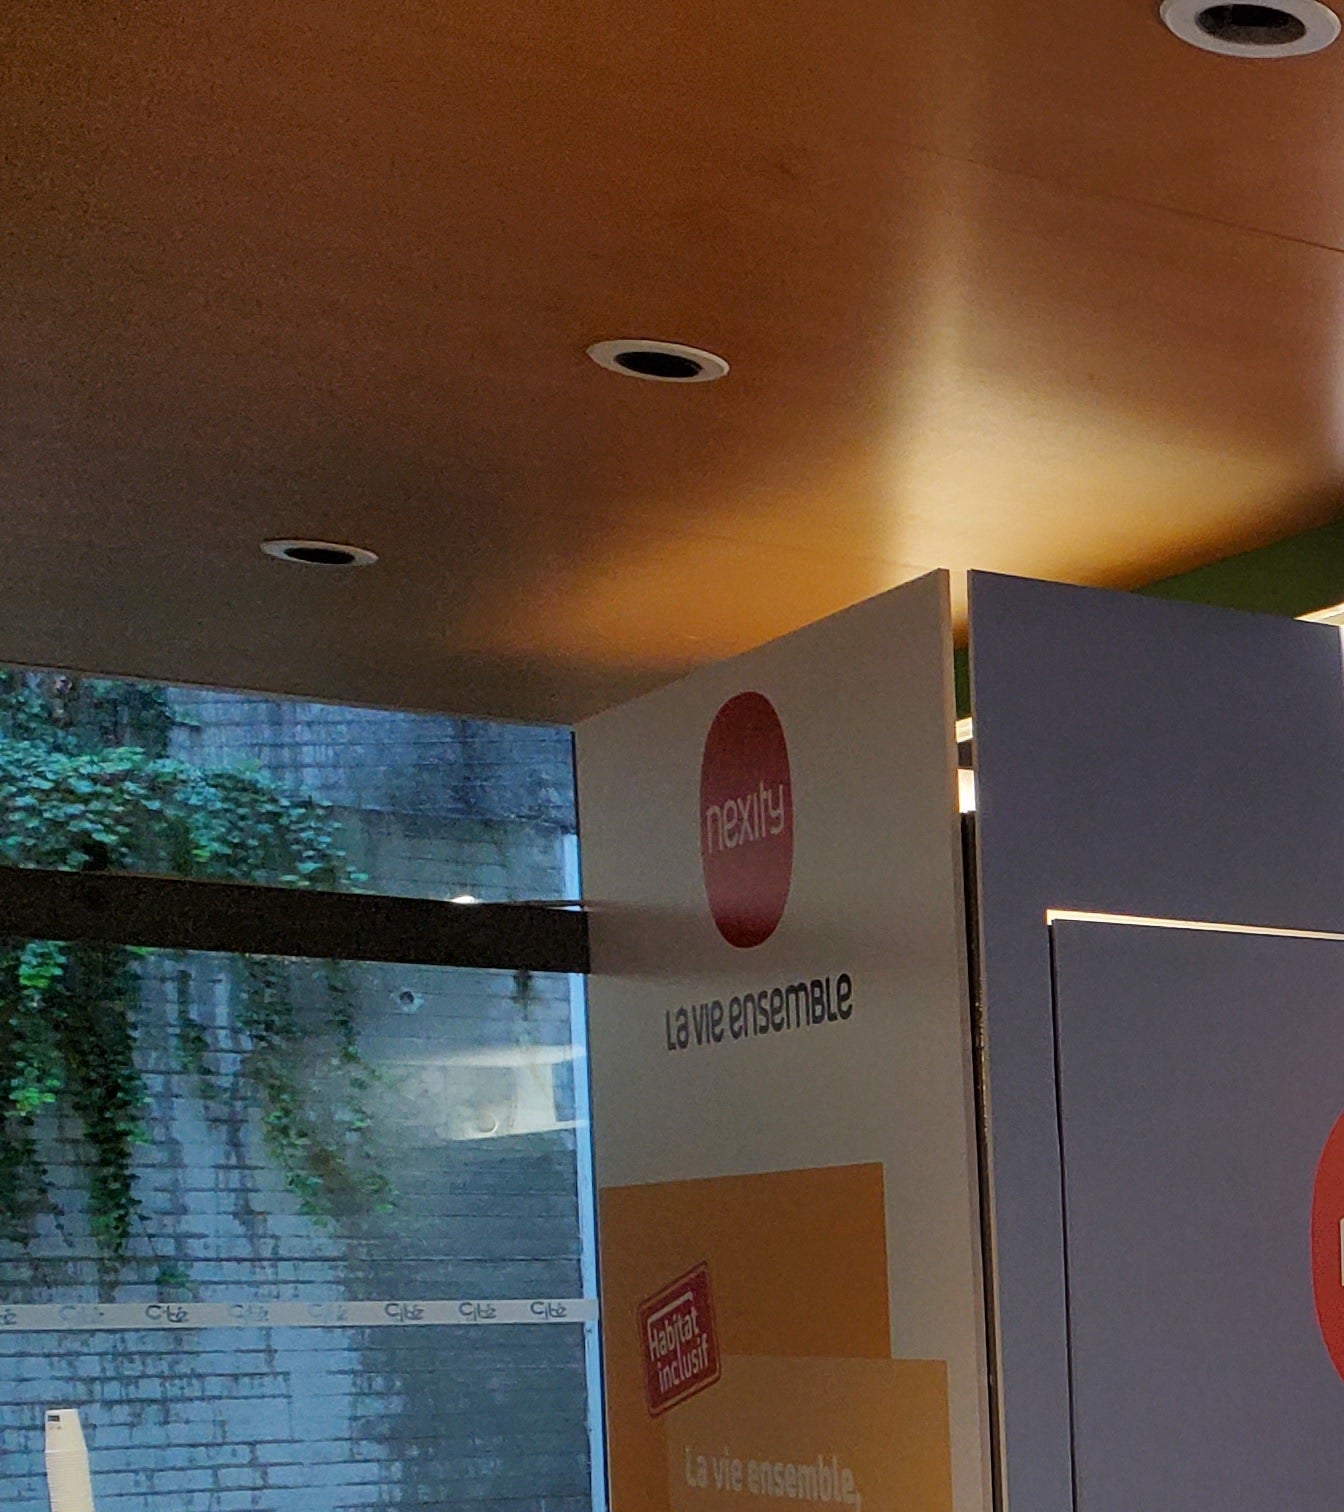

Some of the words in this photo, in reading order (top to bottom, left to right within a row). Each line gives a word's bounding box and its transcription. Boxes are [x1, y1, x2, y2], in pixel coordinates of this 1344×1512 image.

[706, 782, 784, 854] nexity
[648, 1307, 699, 1362] Habitat
[657, 1334, 708, 1394] inclusif
[684, 1446, 707, 1489] La
[713, 1446, 743, 1492] vie
